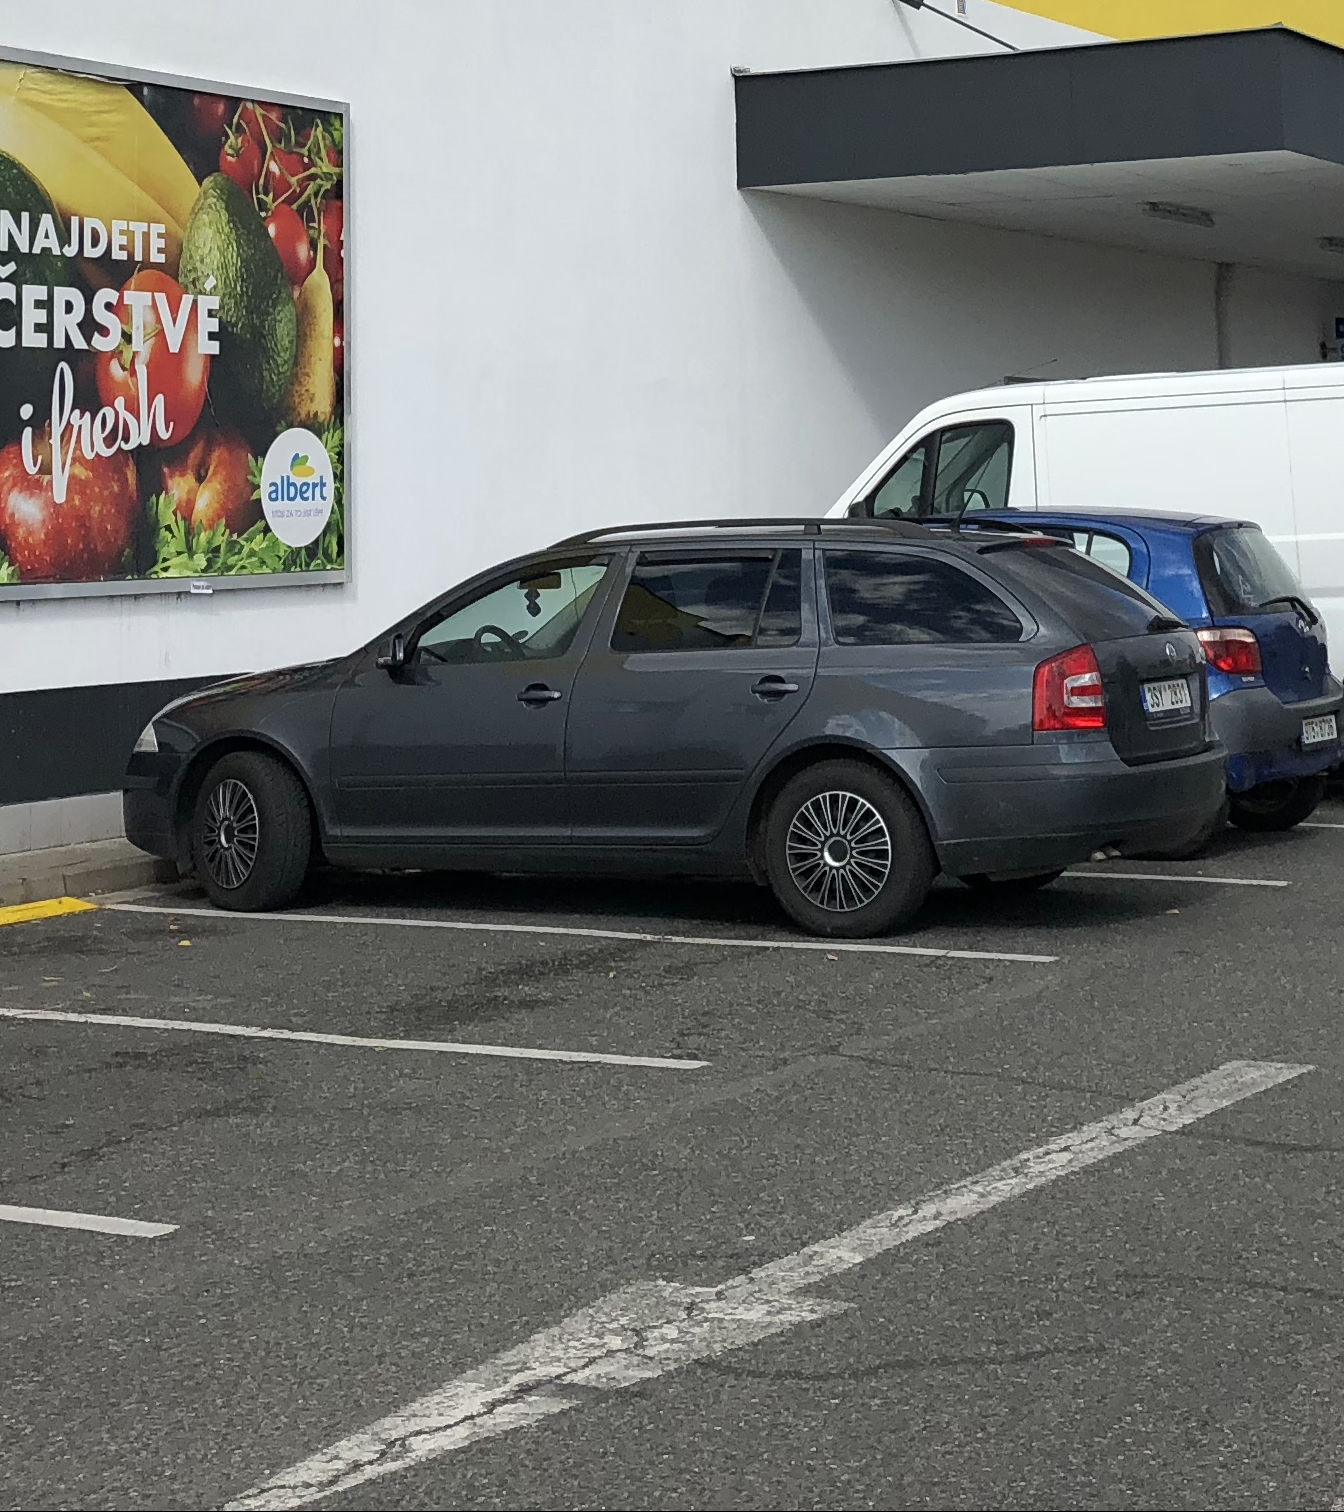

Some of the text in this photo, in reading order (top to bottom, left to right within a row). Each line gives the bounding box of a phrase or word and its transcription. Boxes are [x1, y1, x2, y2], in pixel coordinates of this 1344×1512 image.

[0, 209, 166, 263] NAJDETE
[20, 361, 173, 504] i fresh
[268, 475, 327, 502] albert
